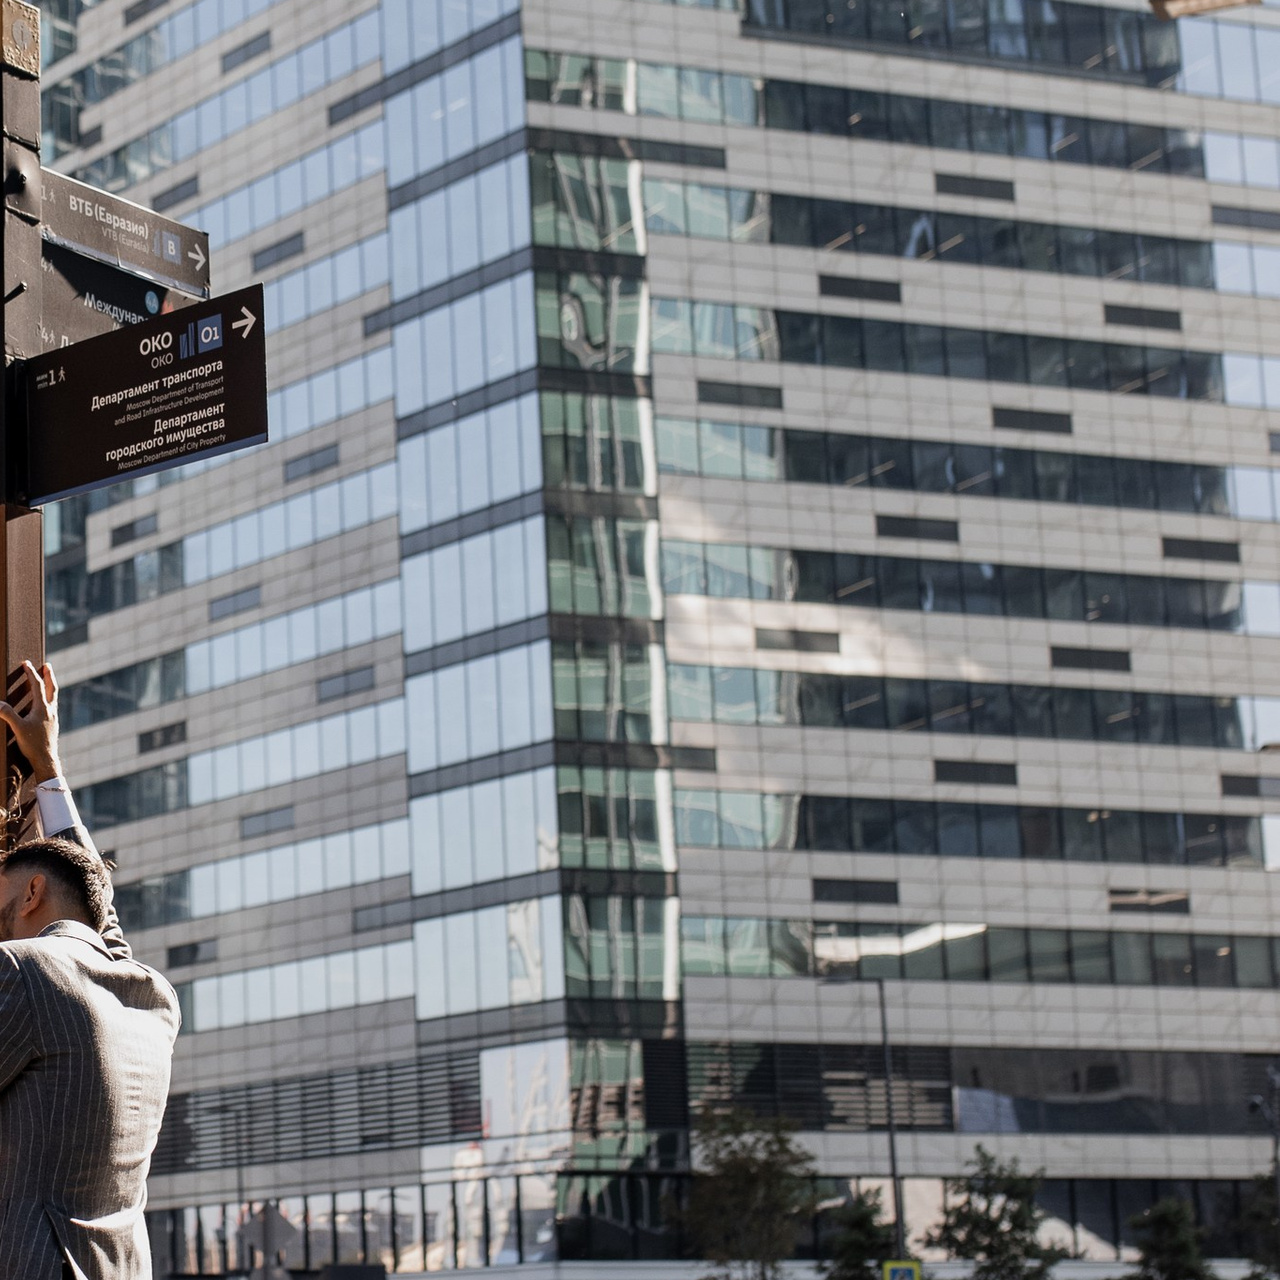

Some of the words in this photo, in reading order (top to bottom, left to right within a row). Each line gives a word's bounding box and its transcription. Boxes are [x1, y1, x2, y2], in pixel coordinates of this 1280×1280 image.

[69, 195, 93, 217] ВТБ
[95, 204, 149, 240] (Евразия)
[101, 227, 118, 240] VTB
[40, 256, 48, 271] 4
[41, 327, 49, 342] 4
[139, 331, 173, 355] ОКО
[151, 352, 174, 369] OKO
[49, 369, 56, 385] 1
[91, 379, 160, 412] Департамент
[162, 360, 223, 388] транспорта
[114, 415, 126, 426] and
[126, 411, 142, 422] Road
[143, 400, 183, 418] Infrastructure
[184, 386, 224, 405] Development
[126, 398, 151, 411] Moscow
[151, 387, 187, 404] Department
[187, 383, 195, 393] of
[195, 376, 224, 390] Transport
[154, 403, 225, 435] Департамент
[106, 435, 164, 462] городского
[166, 418, 225, 445] имущества
[117, 457, 143, 471] Moscow
[143, 446, 179, 463] Department
[179, 443, 186, 453] of
[186, 441, 199, 453] City
[199, 433, 226, 448] Property
